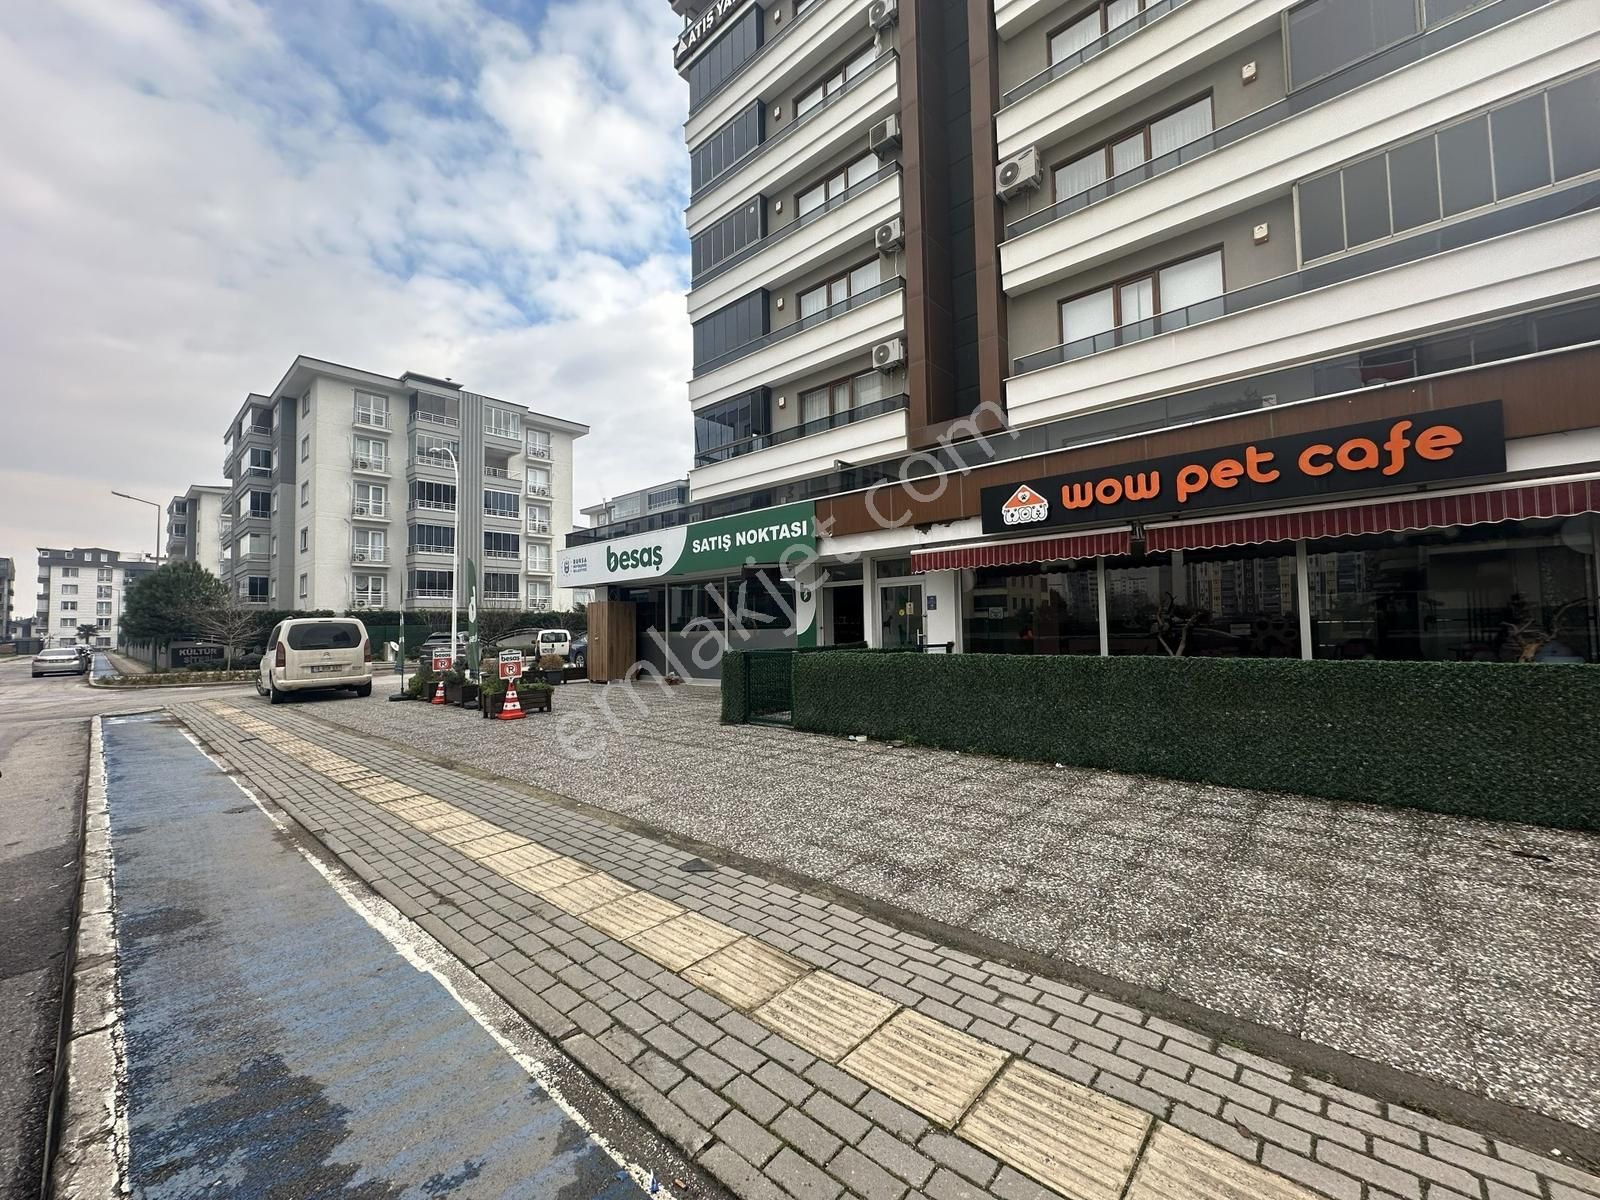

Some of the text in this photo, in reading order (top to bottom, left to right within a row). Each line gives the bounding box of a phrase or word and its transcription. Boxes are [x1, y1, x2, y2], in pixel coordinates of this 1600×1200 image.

[1060, 420, 1464, 510] wow pet cafe
[692, 520, 808, 554] SATIŞ NOKTASI
[606, 545, 663, 573] besaş
[179, 647, 217, 656] KÜLTÜR
